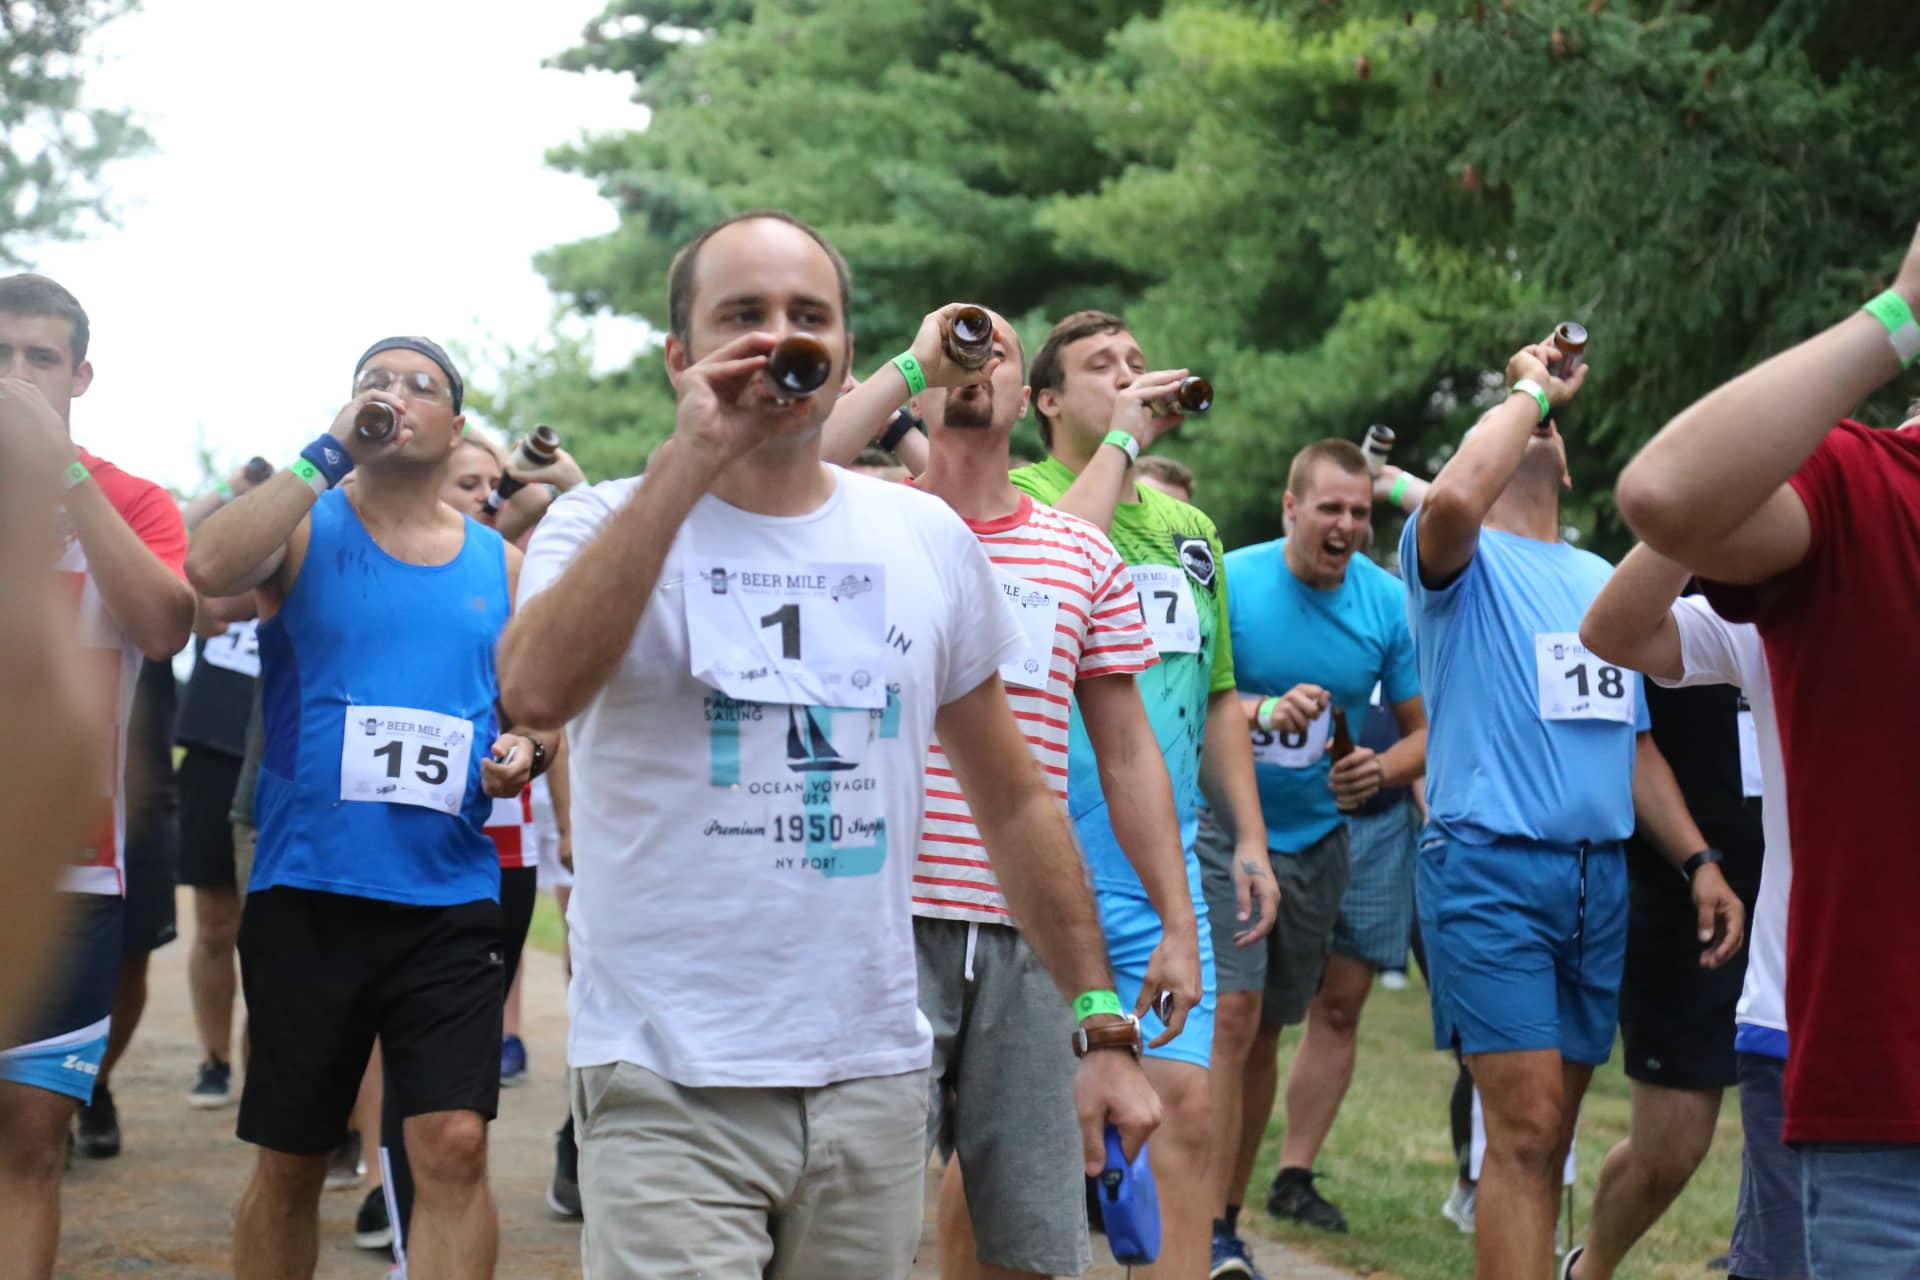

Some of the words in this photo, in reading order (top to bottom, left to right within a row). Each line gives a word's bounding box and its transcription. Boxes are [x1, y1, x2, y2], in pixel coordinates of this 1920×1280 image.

[742, 572, 782, 588] BEER
[786, 575, 826, 589] MILE
[761, 604, 801, 660] 1
[1564, 664, 1625, 699] 18
[704, 711, 763, 721] SAILING
[387, 720, 415, 732] BEER
[418, 724, 441, 737] MILE
[373, 741, 449, 785] 15
[749, 783, 803, 794] OCEAN
[812, 779, 876, 792] VOYAGER
[802, 794, 830, 805] USA
[704, 819, 766, 836] Premium
[774, 815, 842, 843] 1950
[776, 858, 795, 869] NY
[802, 858, 836, 869] PORT
